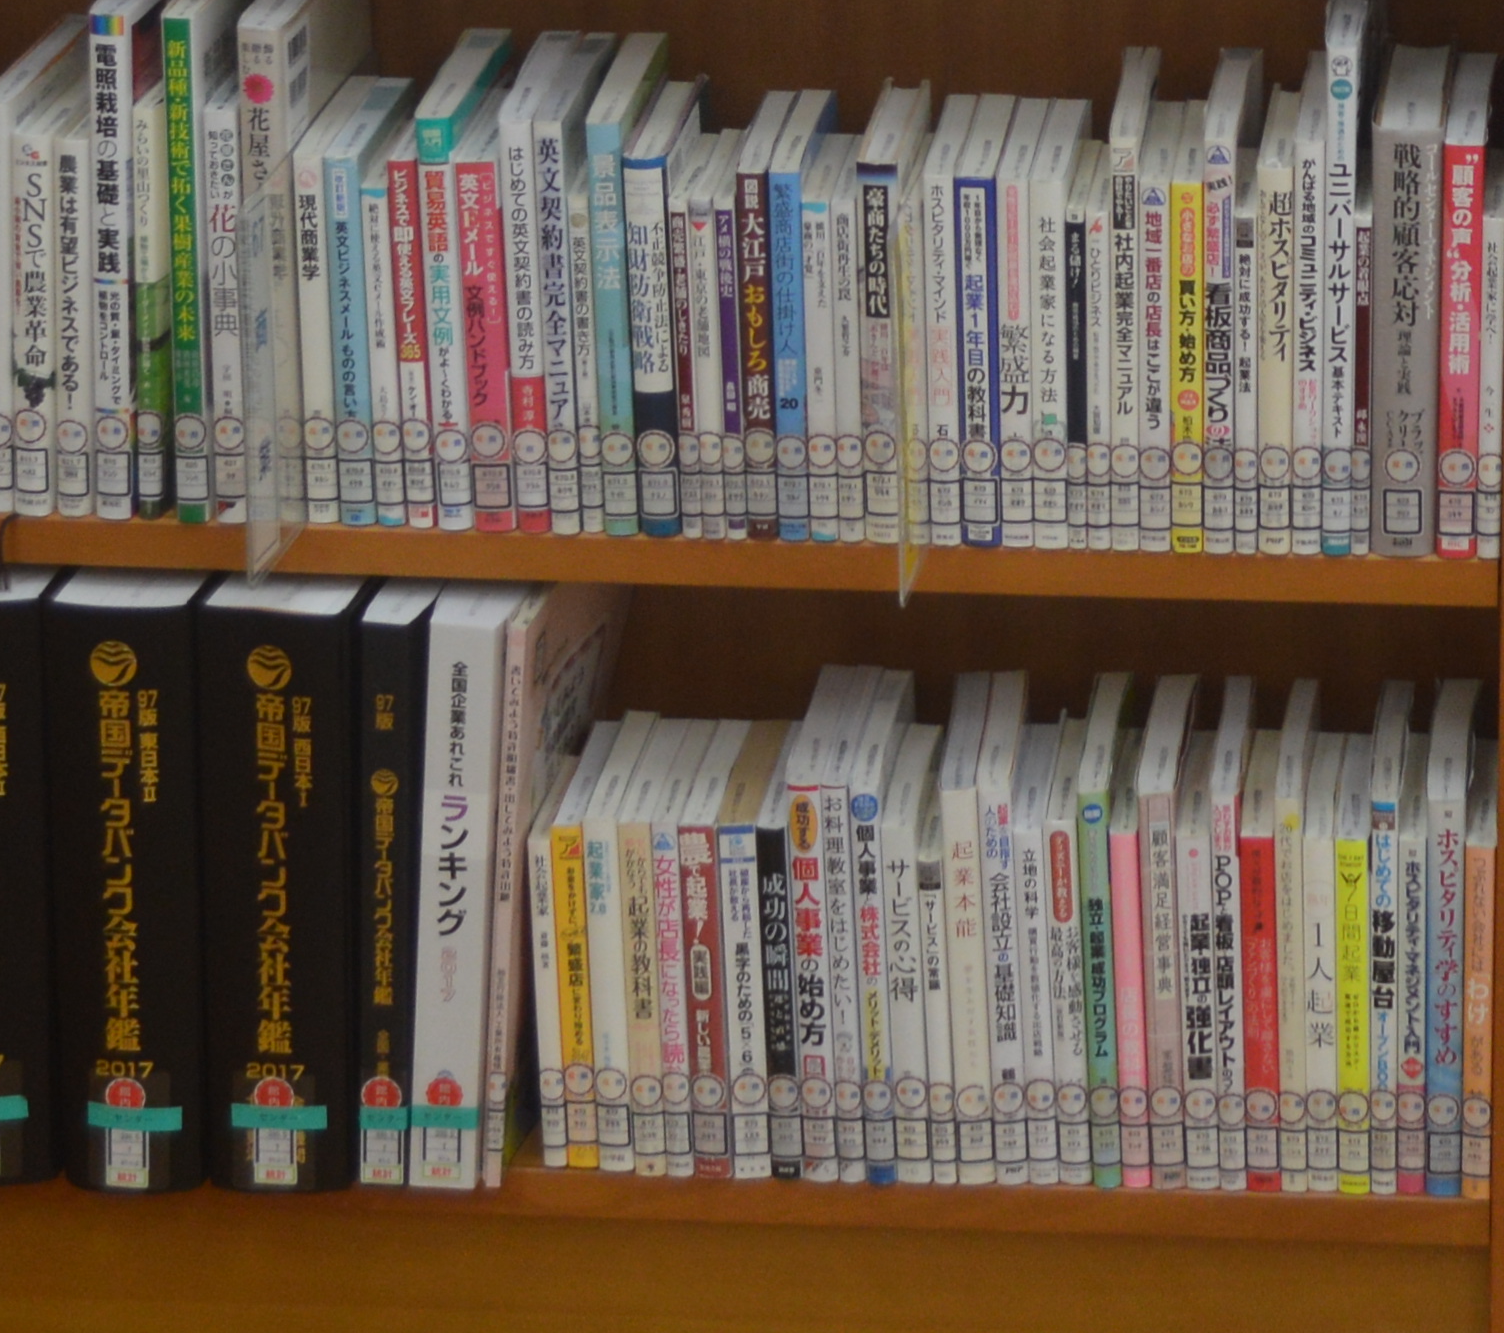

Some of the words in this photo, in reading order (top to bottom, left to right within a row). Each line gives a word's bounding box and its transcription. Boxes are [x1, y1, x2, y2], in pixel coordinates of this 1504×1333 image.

[22, 172, 48, 368] SNSで農業革命
[58, 155, 80, 411] 農業は有望ビジネスである！
[167, 40, 195, 342] 新品種・新技術で拓く果樹産業の未来
[864, 188, 888, 315] 豪商たちの時代
[1391, 142, 1422, 327] 戦略的顧客応対
[1038, 215, 1059, 404] 社会起業家になる方法
[1114, 234, 1136, 417] 社内起業完全マニュアル
[446, 661, 469, 789] 全国企業あれこれ
[98, 688, 142, 1053] 帝国データバンク会社年鑑
[255, 695, 294, 1056] 帝国データバンク会社年鑑
[436, 794, 469, 938] ランキング
[886, 859, 917, 1003] サービスの心得
[1433, 828, 1459, 1066] ホスピタリティ学のすすめ
